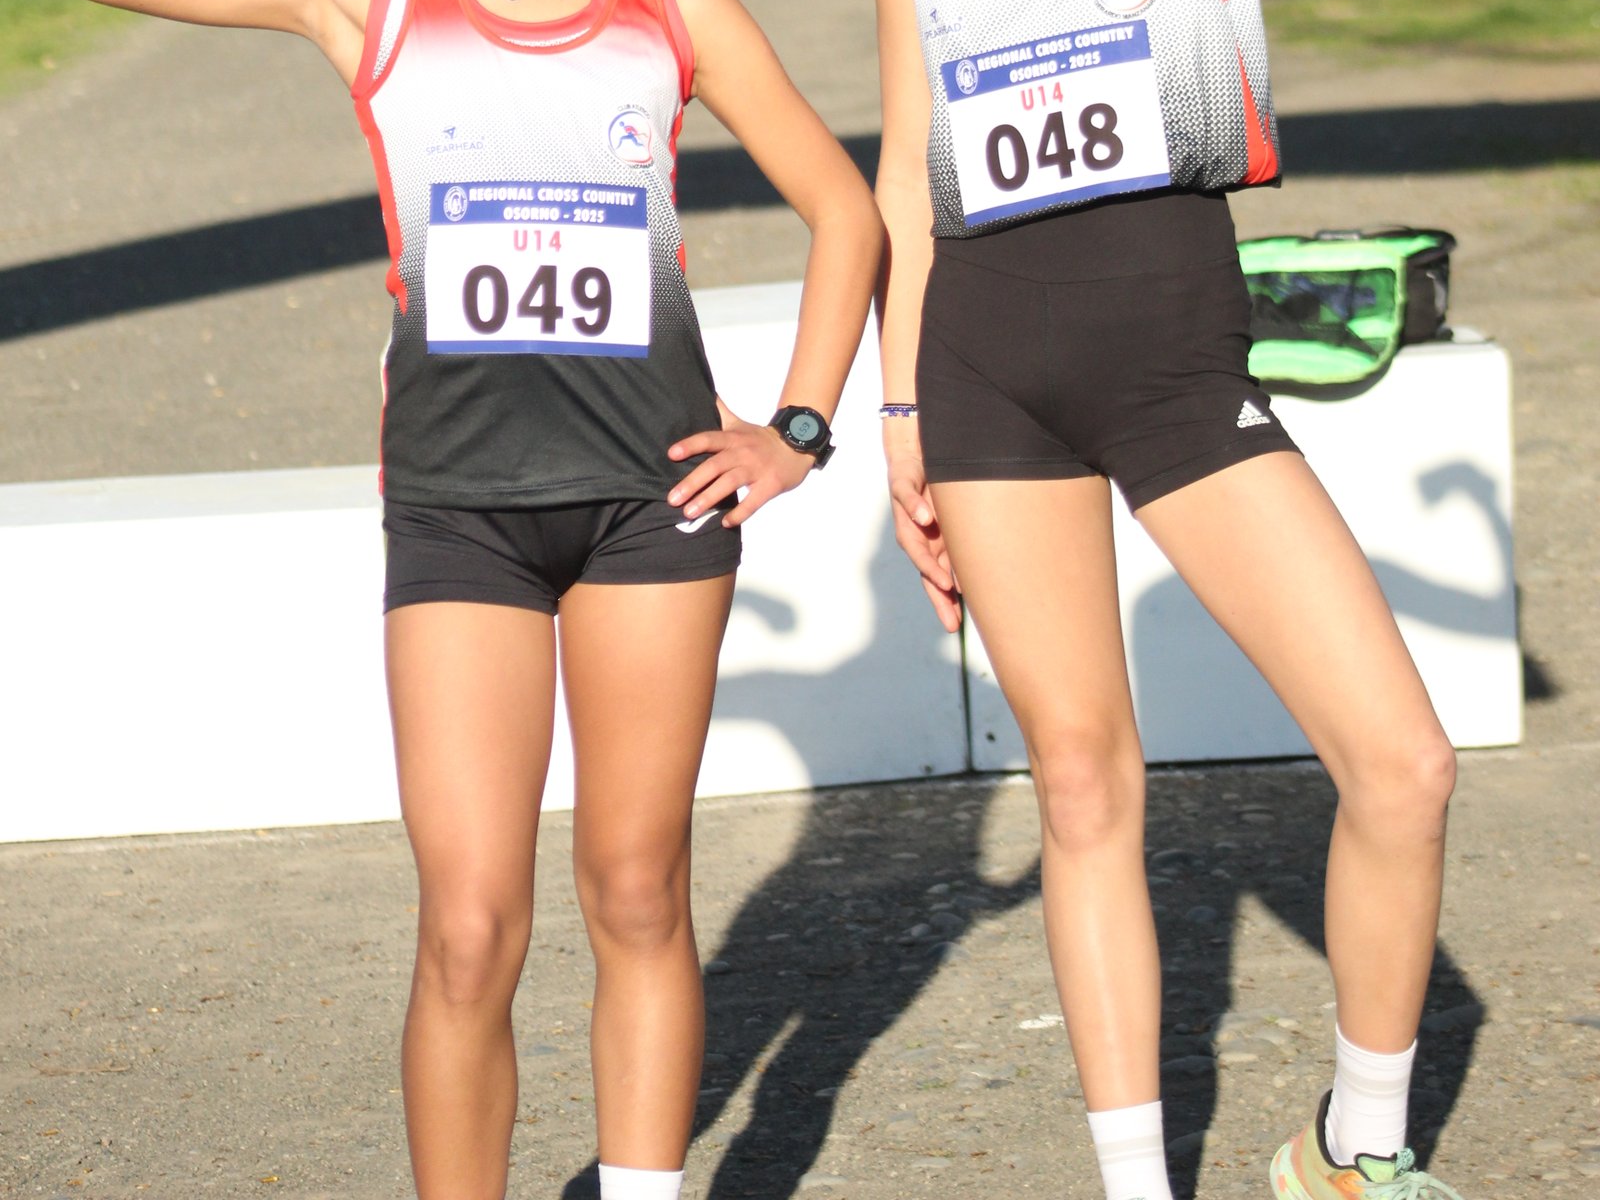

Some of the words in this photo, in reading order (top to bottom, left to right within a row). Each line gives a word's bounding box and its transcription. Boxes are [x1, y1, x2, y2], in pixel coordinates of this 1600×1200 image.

[977, 47, 1034, 72] REGIONAL
[1035, 37, 1072, 57] CROSS
[1075, 26, 1133, 48] COUNTRY
[1009, 60, 1058, 84] OSORNO
[1069, 51, 1101, 70] 2025
[1020, 81, 1064, 111] U14
[425, 141, 484, 156] SPEARHEAD
[985, 102, 1124, 192] 048
[469, 187, 534, 202] REGIONAL
[537, 188, 579, 203] CROSS
[582, 190, 635, 206] COUNTRY
[503, 207, 561, 221] OSORNO
[573, 209, 605, 223] 2025
[513, 229, 563, 252] U14
[462, 264, 612, 337] 049
[1236, 415, 1271, 428] adidas
